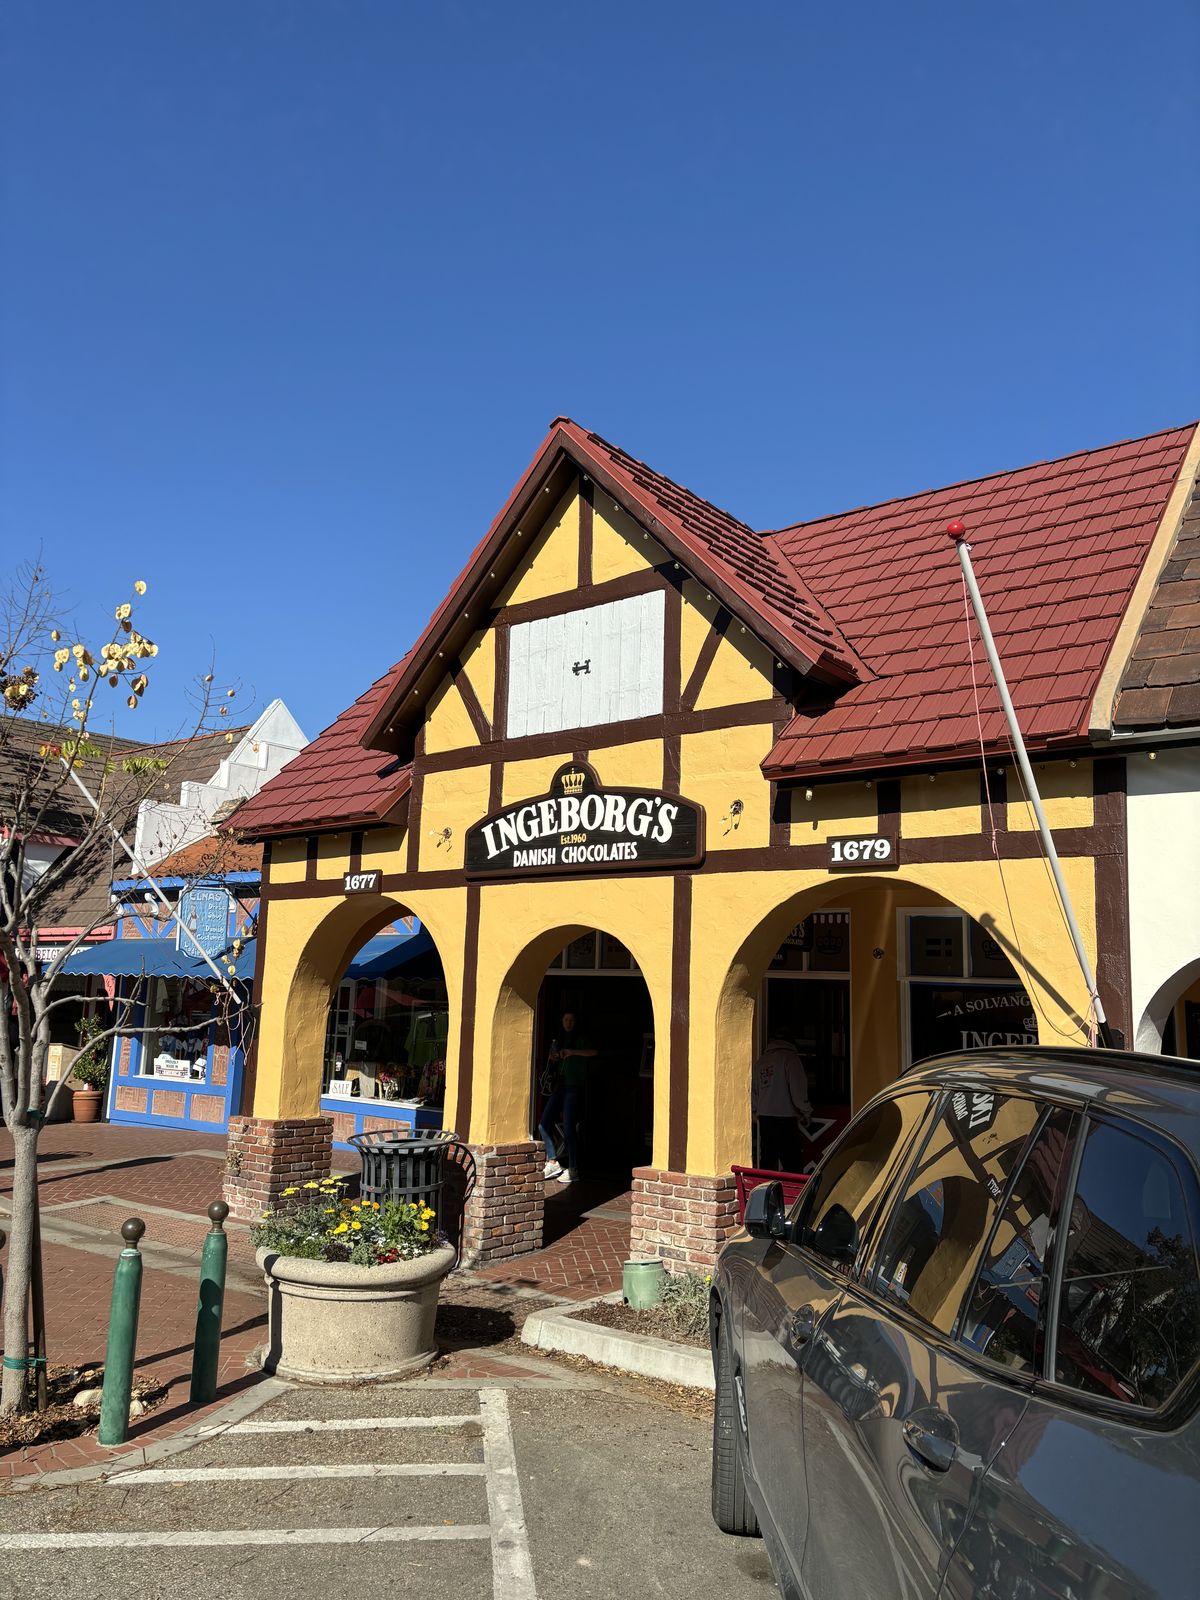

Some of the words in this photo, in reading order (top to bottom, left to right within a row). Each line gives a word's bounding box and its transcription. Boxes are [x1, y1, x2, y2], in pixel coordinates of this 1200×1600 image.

[481, 794, 679, 860] INGEBORG'S
[513, 847, 556, 868] DANISH
[561, 841, 638, 864] CHOCOLATES
[831, 838, 891, 862] 1679
[344, 873, 377, 891] 1677
[954, 1004, 964, 1016] A
[966, 995, 1031, 1013] SOLVANG
[332, 1083, 349, 1095] SALE
